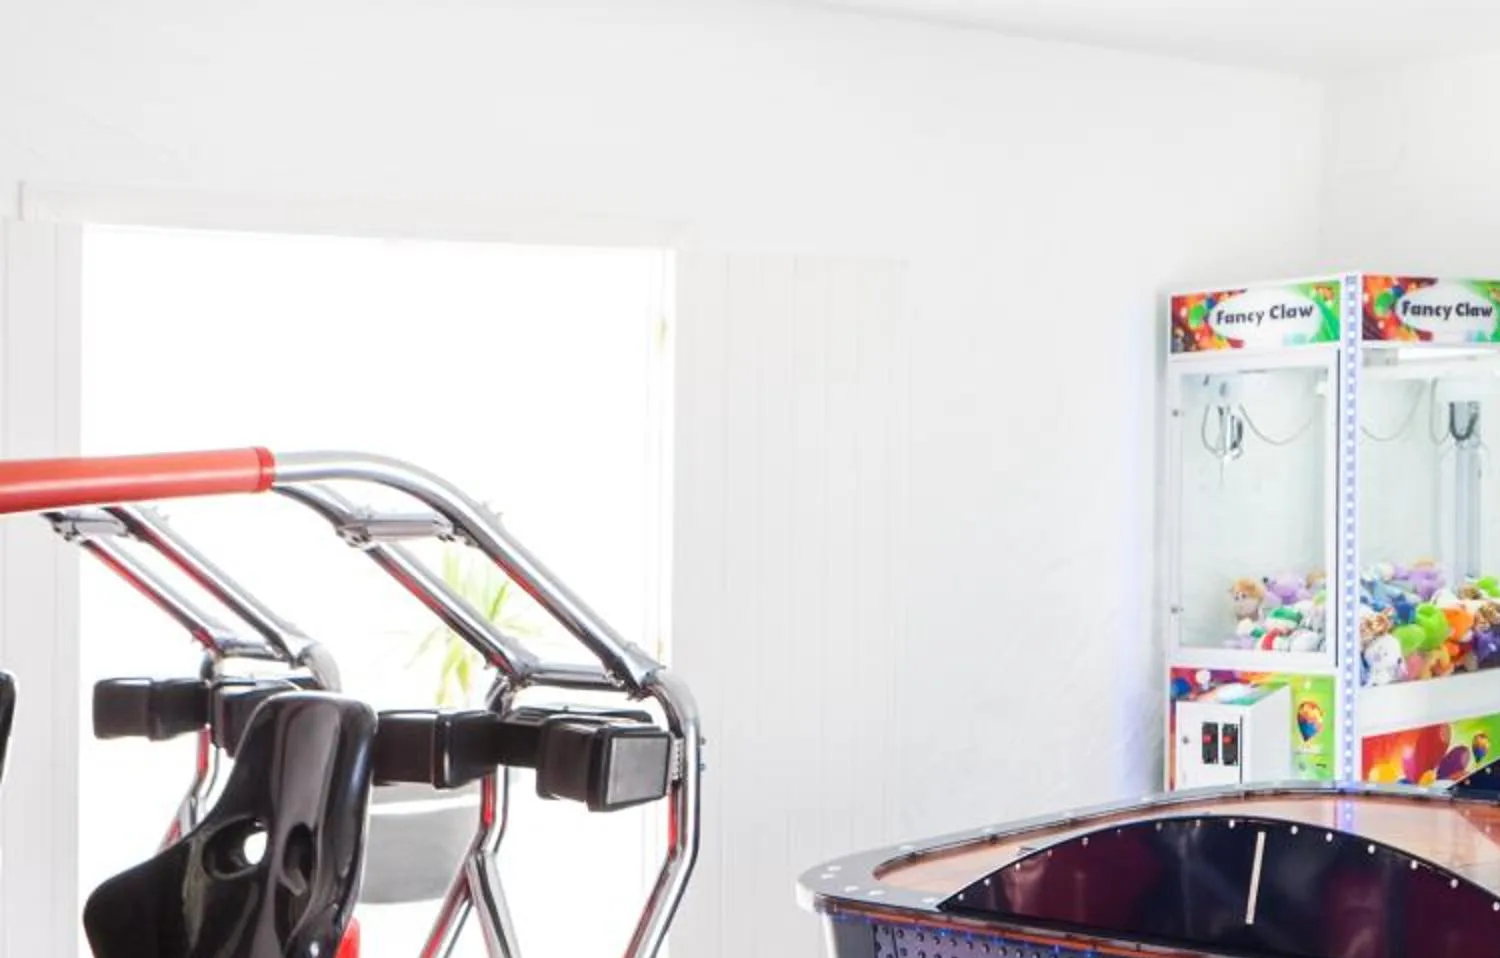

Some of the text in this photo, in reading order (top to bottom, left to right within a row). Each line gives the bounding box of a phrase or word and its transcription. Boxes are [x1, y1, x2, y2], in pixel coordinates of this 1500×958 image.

[1216, 304, 1314, 327] Fancy Claw
[1401, 300, 1493, 320] Fancy Claw
